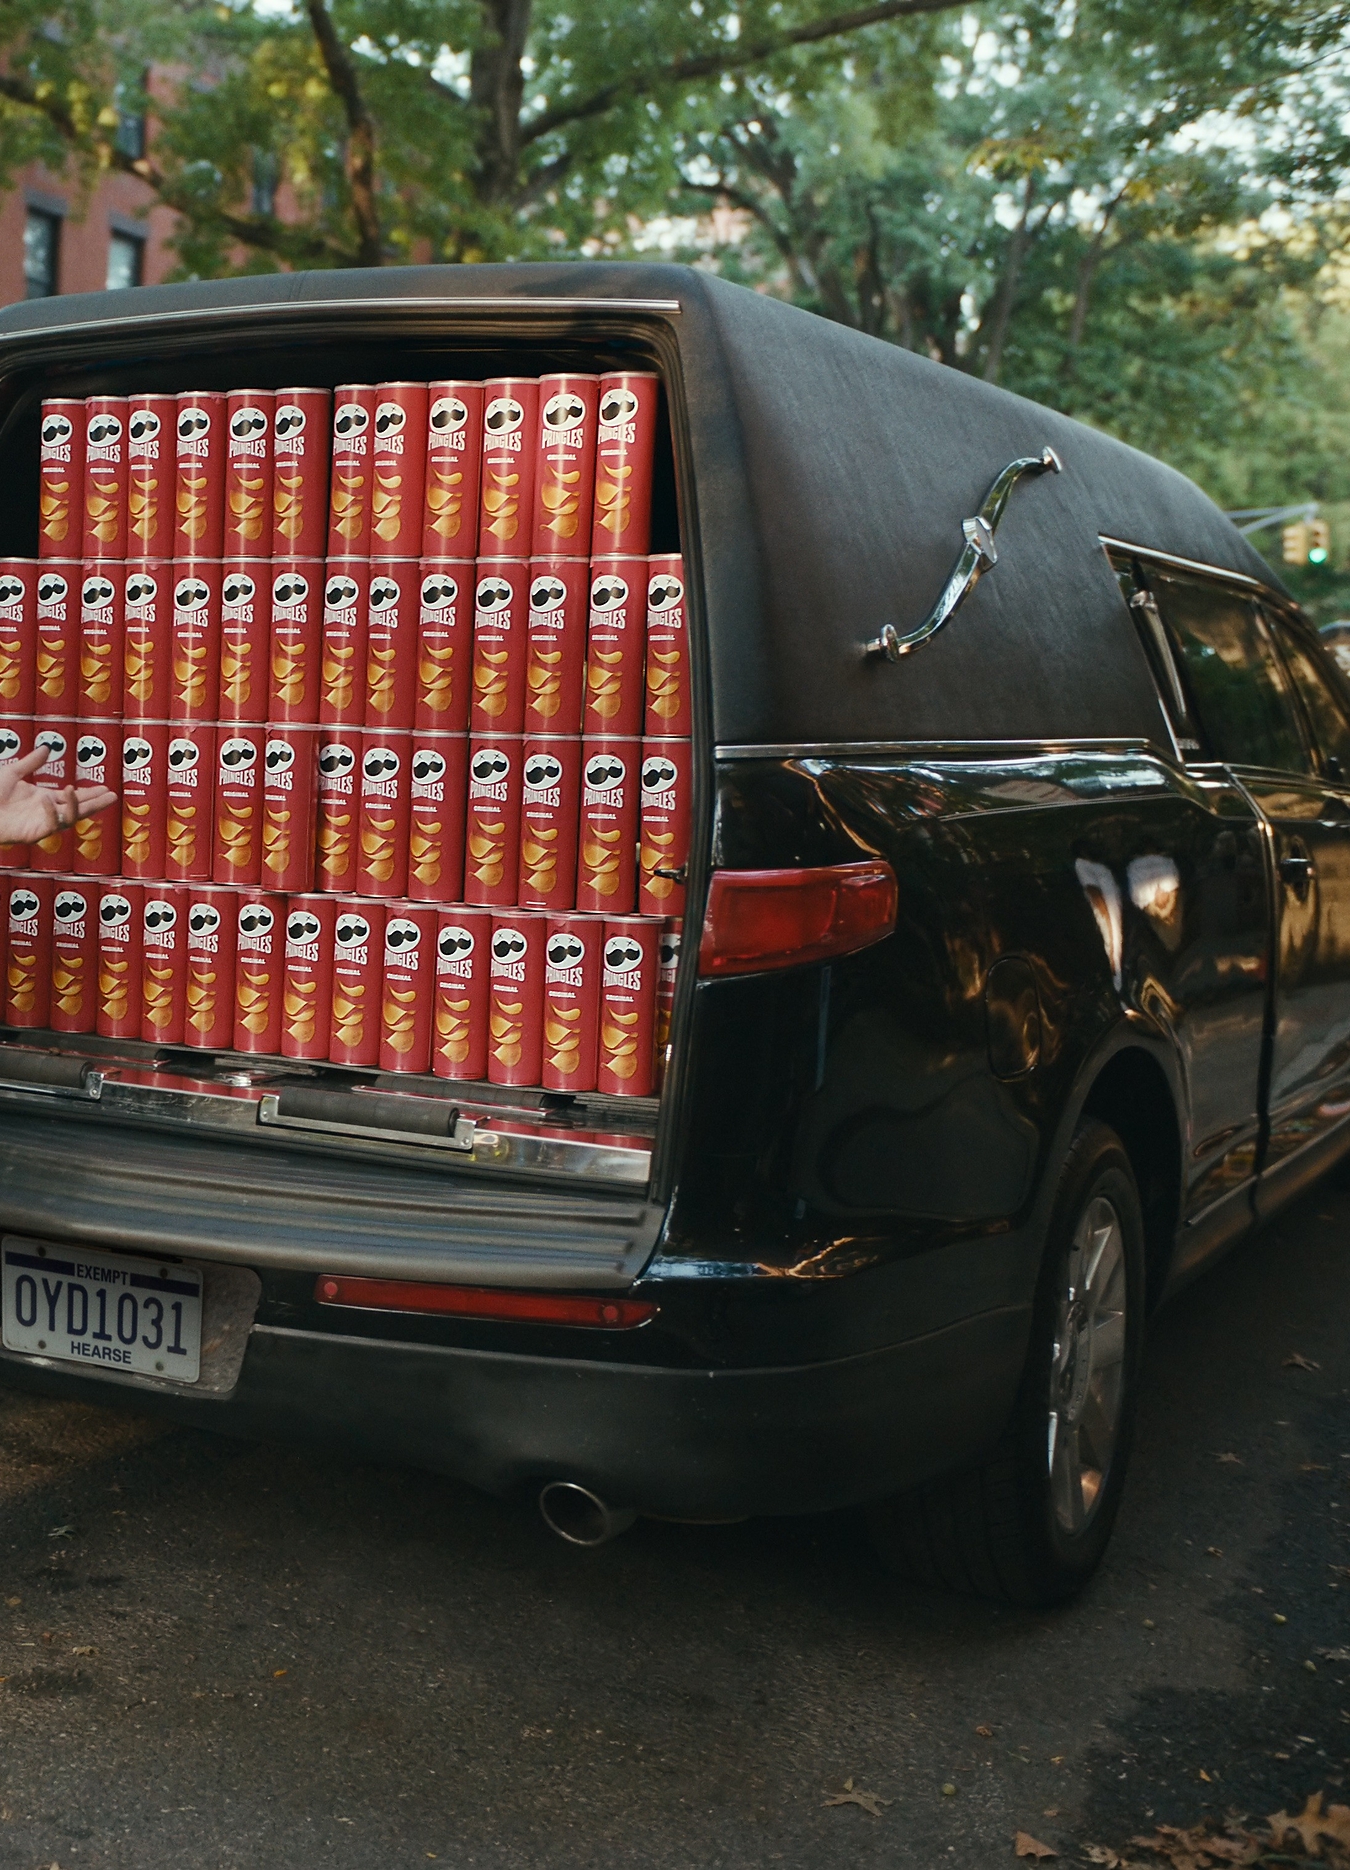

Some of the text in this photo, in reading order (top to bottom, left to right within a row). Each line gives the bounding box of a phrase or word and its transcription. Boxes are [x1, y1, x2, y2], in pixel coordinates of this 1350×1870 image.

[229, 439, 266, 458] PRINGLES
[428, 430, 466, 451] PRINGLES
[484, 431, 522, 452] PRINGLES
[542, 428, 583, 449] PRINGLES
[219, 768, 255, 787] PRINGLES
[362, 779, 398, 799] PRINGLES
[469, 780, 508, 800] PRINGLES
[523, 788, 560, 807] PRINGLES
[584, 788, 623, 808] PRINGLES
[77, 1264, 129, 1286] EXEMPT
[71, 1341, 132, 1364] HEARSE
